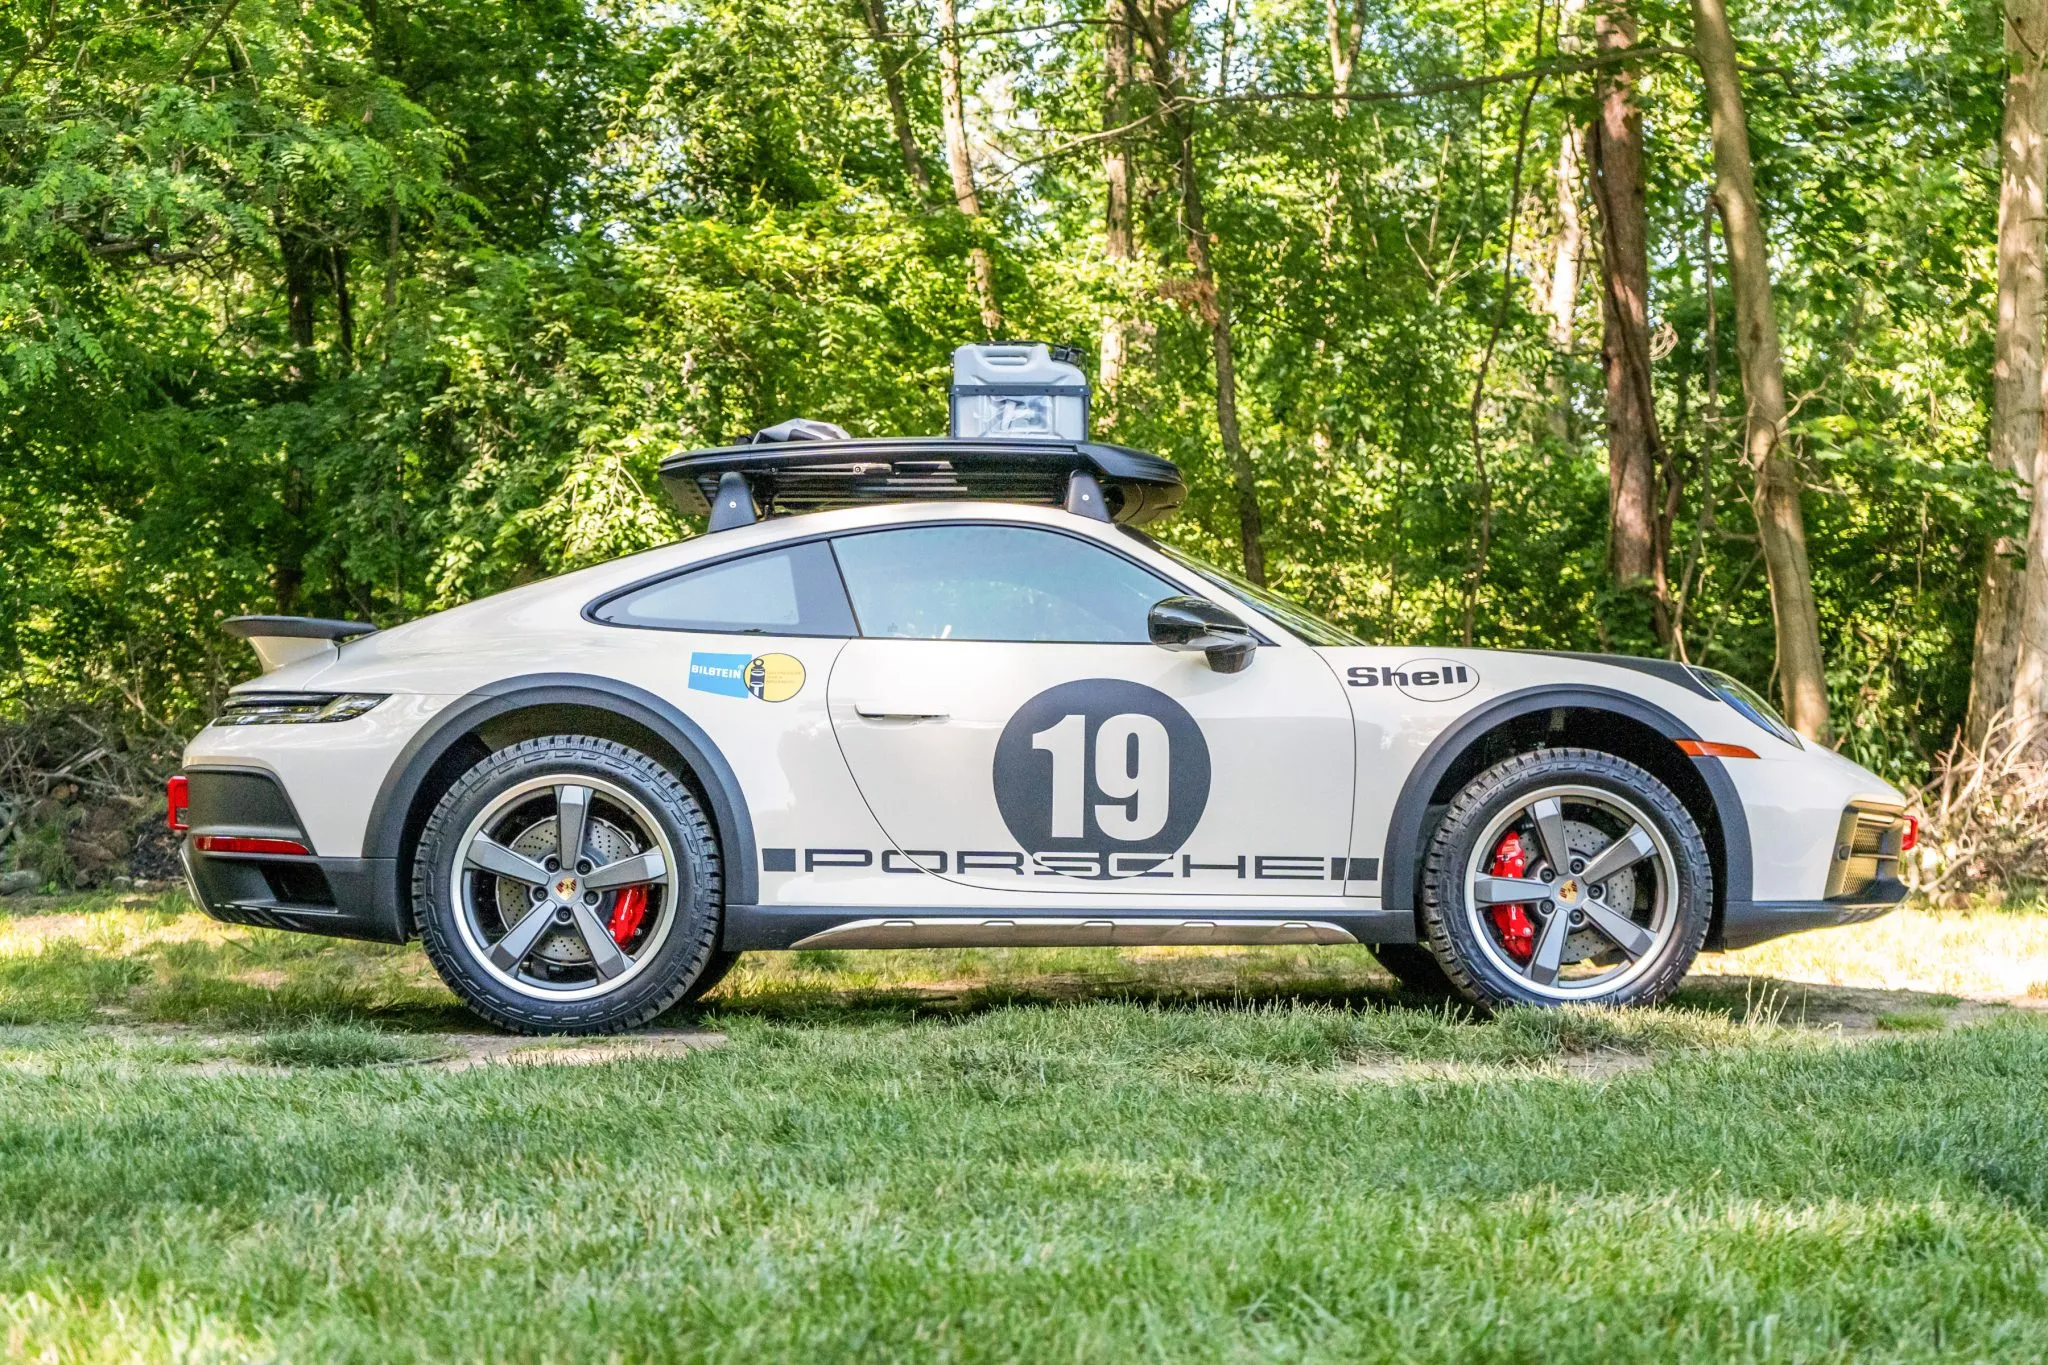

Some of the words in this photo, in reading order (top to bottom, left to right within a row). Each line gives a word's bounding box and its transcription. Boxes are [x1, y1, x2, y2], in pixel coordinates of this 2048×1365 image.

[691, 664, 742, 679] BILSTEIN
[1347, 666, 1468, 687] Shell
[1031, 713, 1170, 841] 19
[804, 848, 1326, 880] PORSCHE
